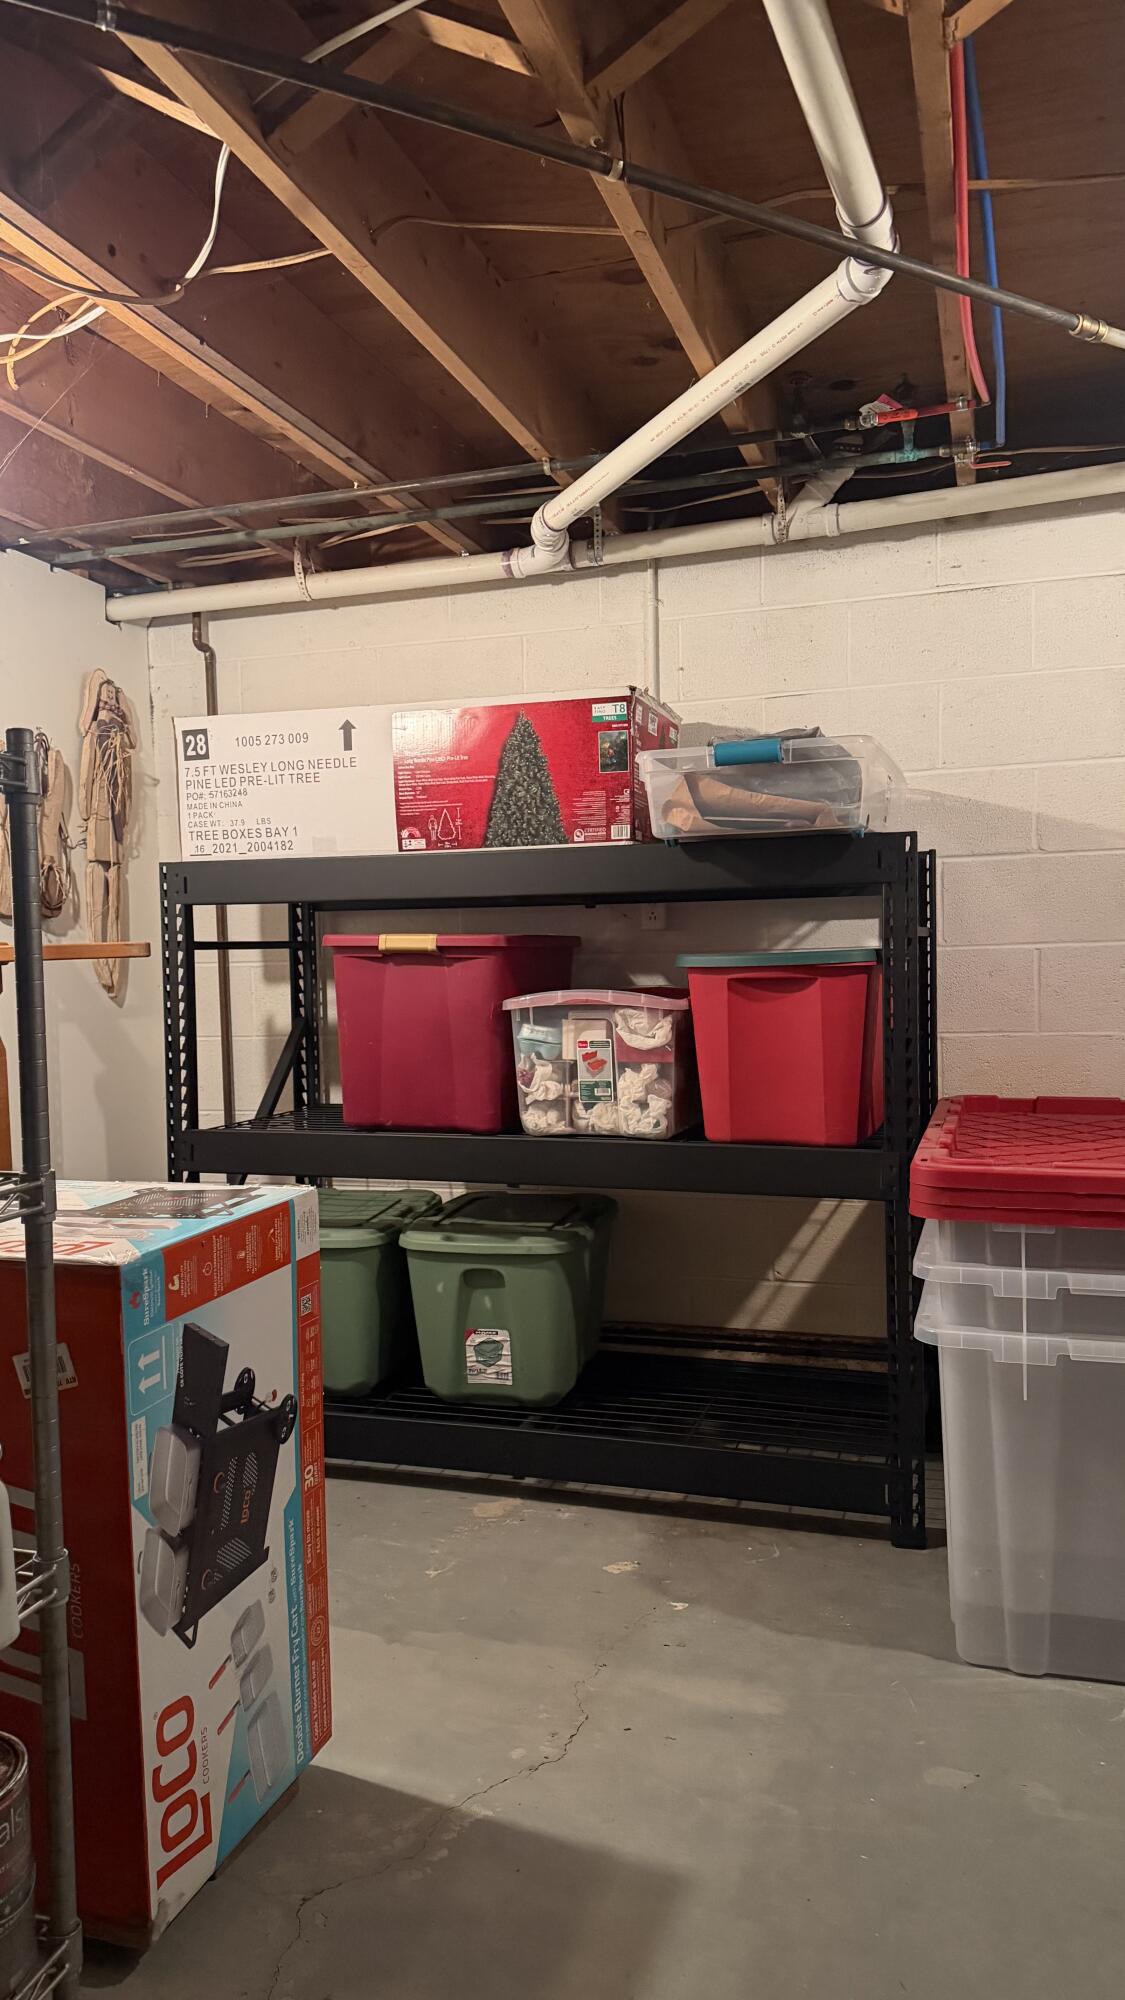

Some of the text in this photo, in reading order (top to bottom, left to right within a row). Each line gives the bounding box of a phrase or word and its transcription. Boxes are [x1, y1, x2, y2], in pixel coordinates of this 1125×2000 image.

[612, 703, 626, 713] T8
[185, 733, 207, 756] 28
[235, 732, 309, 747] 1005 273 009
[184, 756, 357, 778] 7.5 FT WESLEY LONG NEEDLE
[185, 772, 320, 790] PINE LED PRE-LIT TREE
[186, 802, 209, 810] MADE
[219, 800, 243, 809] CHINA
[187, 820, 208, 828] CASE
[256, 817, 272, 825] LBS
[188, 826, 298, 841] TREE BOXES BAY 1
[143, 1268, 151, 1326] SureSpark
[304, 1464, 314, 1491] 30
[288, 1519, 296, 1586] SureSpark
[70, 1562, 83, 1641] COOKERS
[291, 1604, 299, 1637] Cart
[292, 1638, 300, 1664] Fry
[296, 1713, 304, 1764] Double
[201, 1726, 210, 1785] COOKERS
